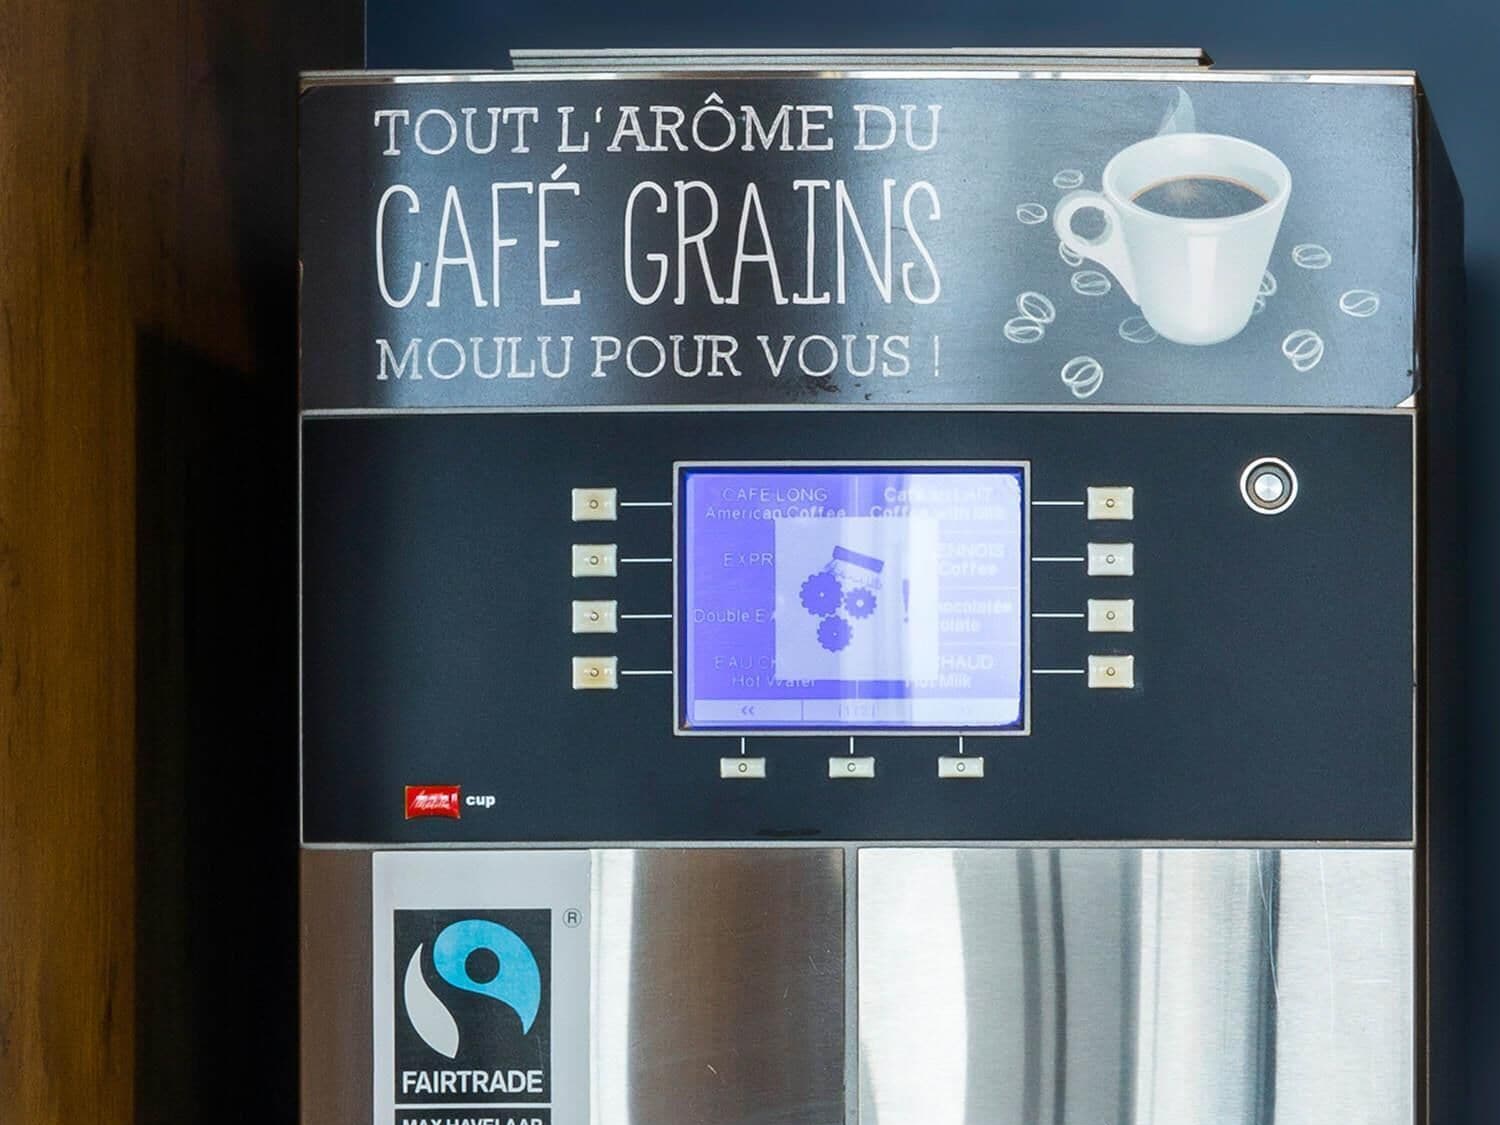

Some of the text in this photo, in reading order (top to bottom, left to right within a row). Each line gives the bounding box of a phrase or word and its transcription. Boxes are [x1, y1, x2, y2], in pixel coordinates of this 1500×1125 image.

[374, 106, 538, 155] TOUT
[853, 104, 941, 151] DU
[375, 163, 941, 308] CAFÉ GRAINS
[375, 335, 572, 381] MOULU
[591, 335, 741, 379] POUR
[757, 334, 910, 379] VOUS
[777, 487, 828, 502] LONG
[465, 795, 496, 809] cup
[402, 1070, 544, 1094] FAIRTRADE
